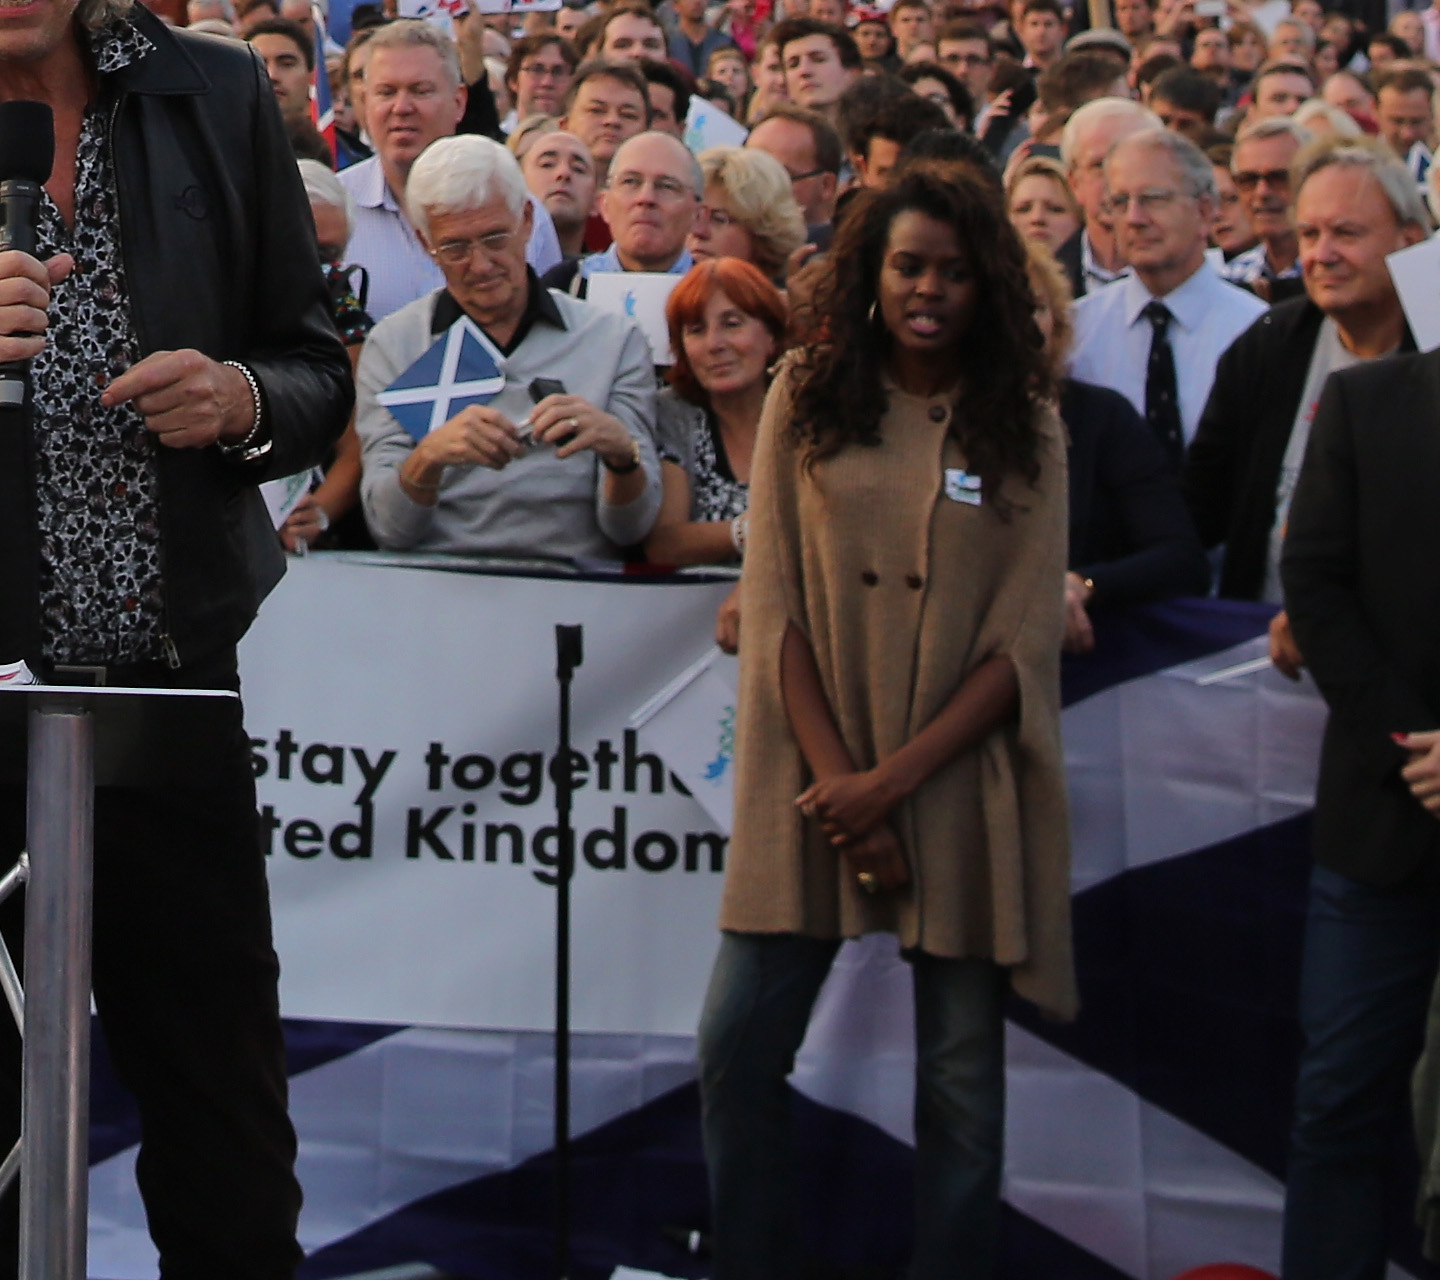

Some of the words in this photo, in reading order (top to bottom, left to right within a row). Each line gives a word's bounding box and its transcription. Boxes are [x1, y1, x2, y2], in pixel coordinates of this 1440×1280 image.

[248, 729, 396, 806] stay
[425, 729, 694, 805] togeth
[405, 803, 730, 886] Kingdom
